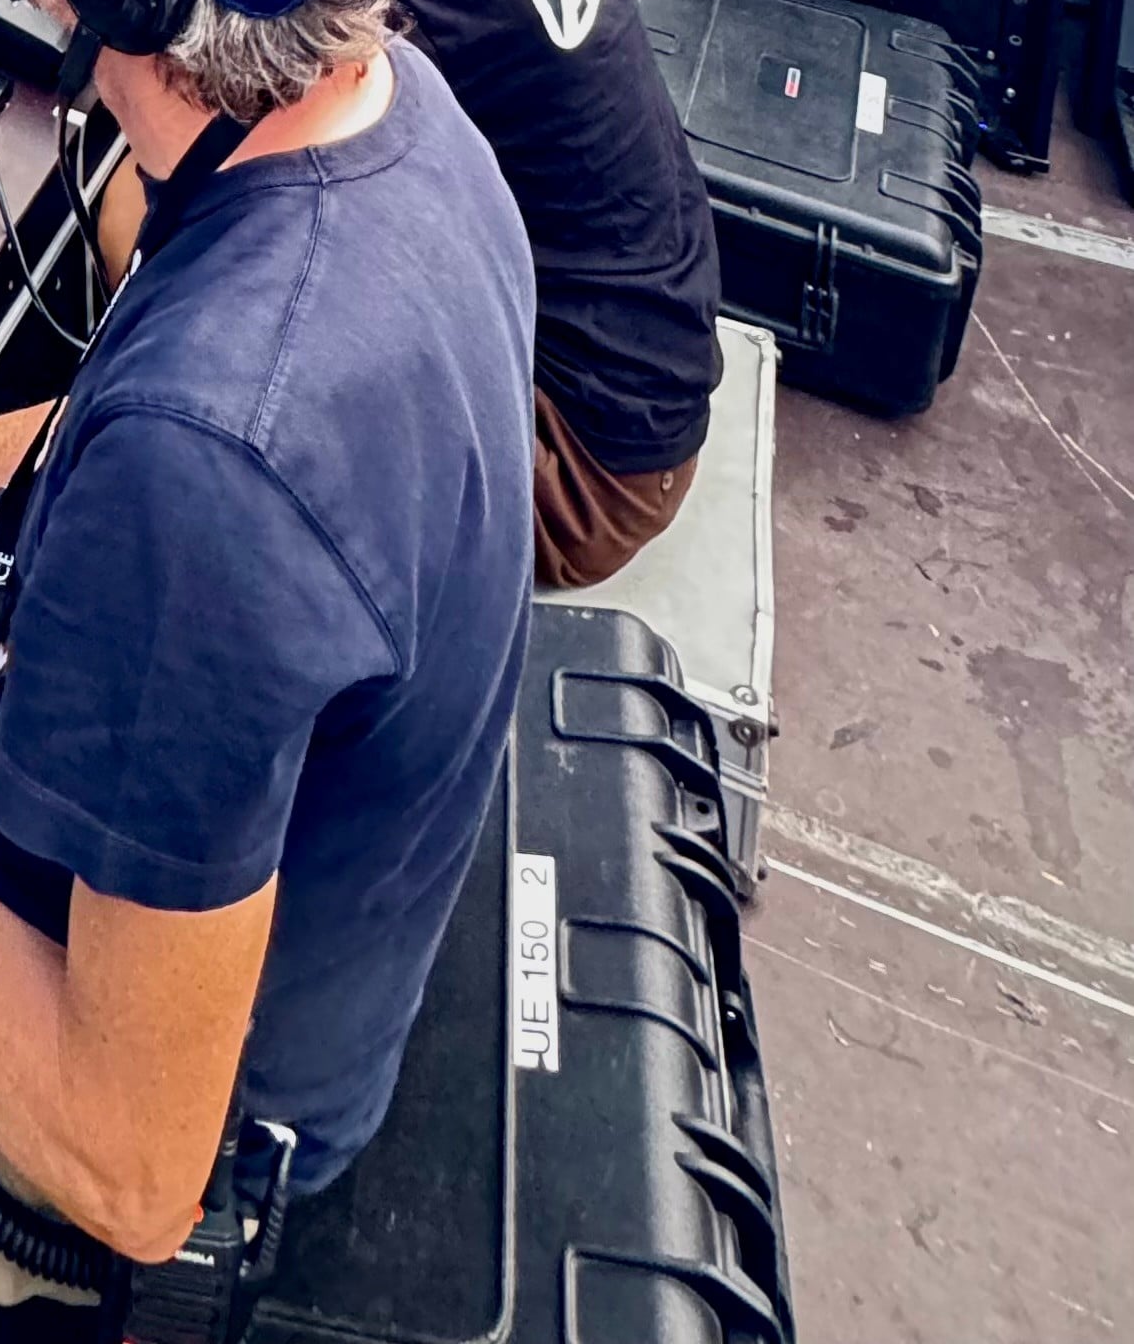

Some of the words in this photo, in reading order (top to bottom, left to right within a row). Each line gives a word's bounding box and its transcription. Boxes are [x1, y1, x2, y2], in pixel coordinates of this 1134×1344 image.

[521, 866, 547, 886] 2
[521, 920, 549, 980] 150
[522, 999, 551, 1060] UE
